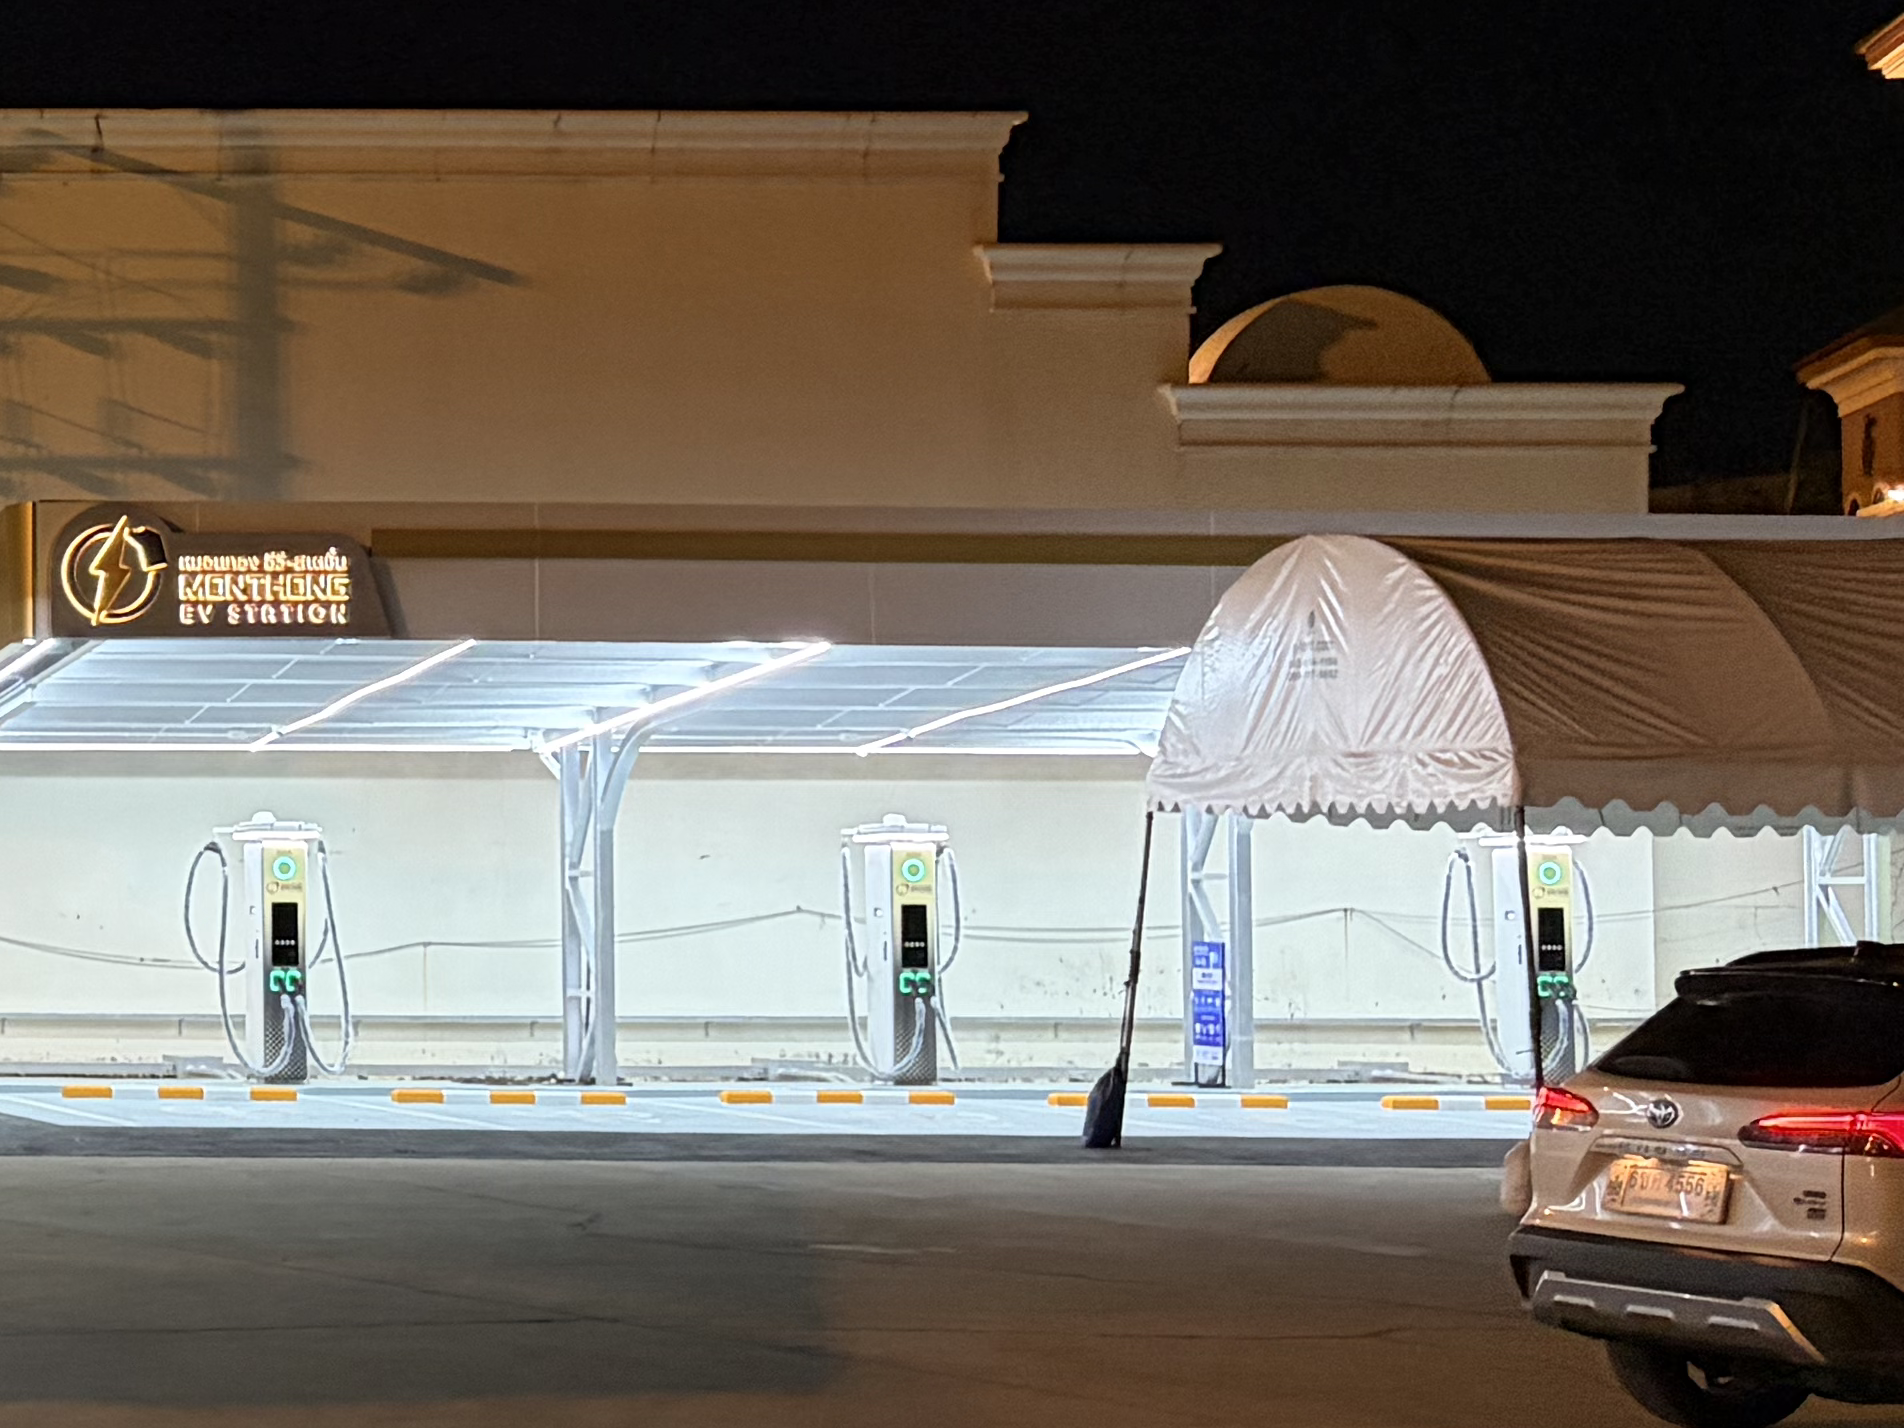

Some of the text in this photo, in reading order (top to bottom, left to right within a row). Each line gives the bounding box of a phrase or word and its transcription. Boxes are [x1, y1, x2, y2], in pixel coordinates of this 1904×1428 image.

[178, 573, 351, 602] MONTHONG
[179, 603, 349, 625] EV STATION
